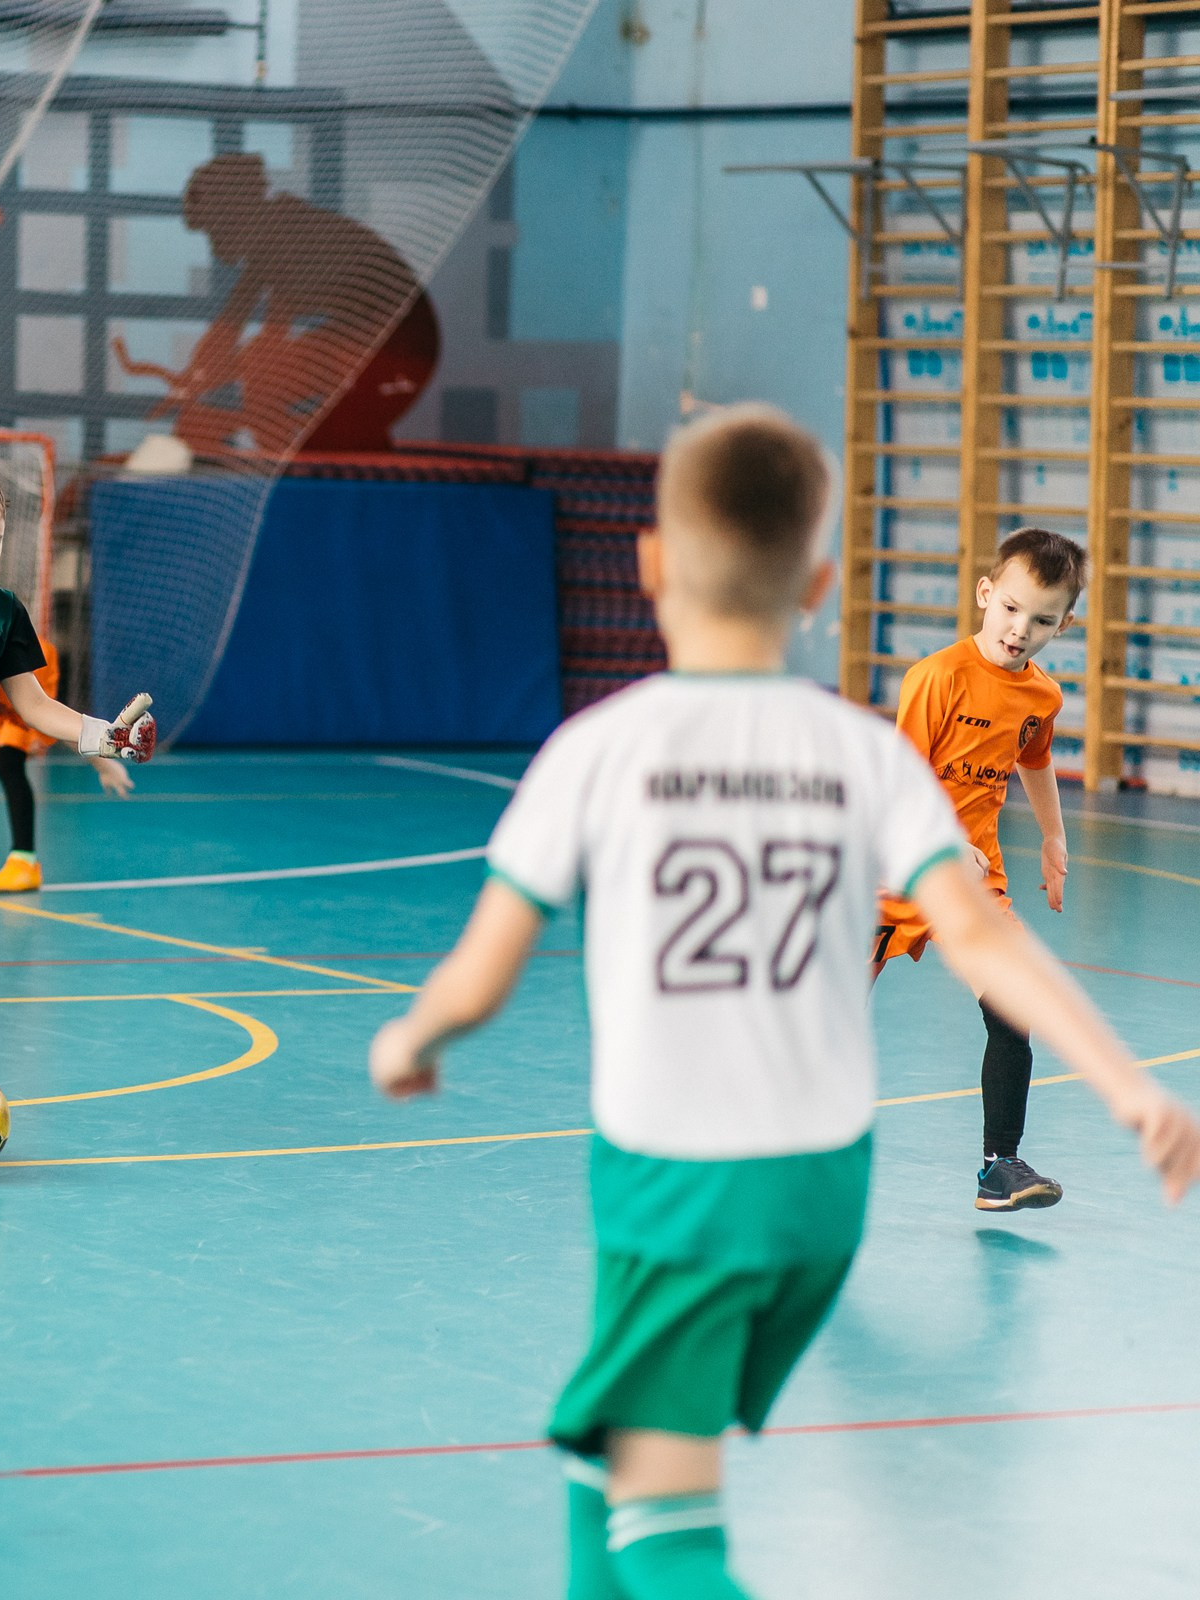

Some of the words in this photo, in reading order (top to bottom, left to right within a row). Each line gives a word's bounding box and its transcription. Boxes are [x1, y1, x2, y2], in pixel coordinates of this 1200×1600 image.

[956, 713, 992, 729] TCM
[652, 838, 842, 995] 27
[873, 925, 896, 963] 7
